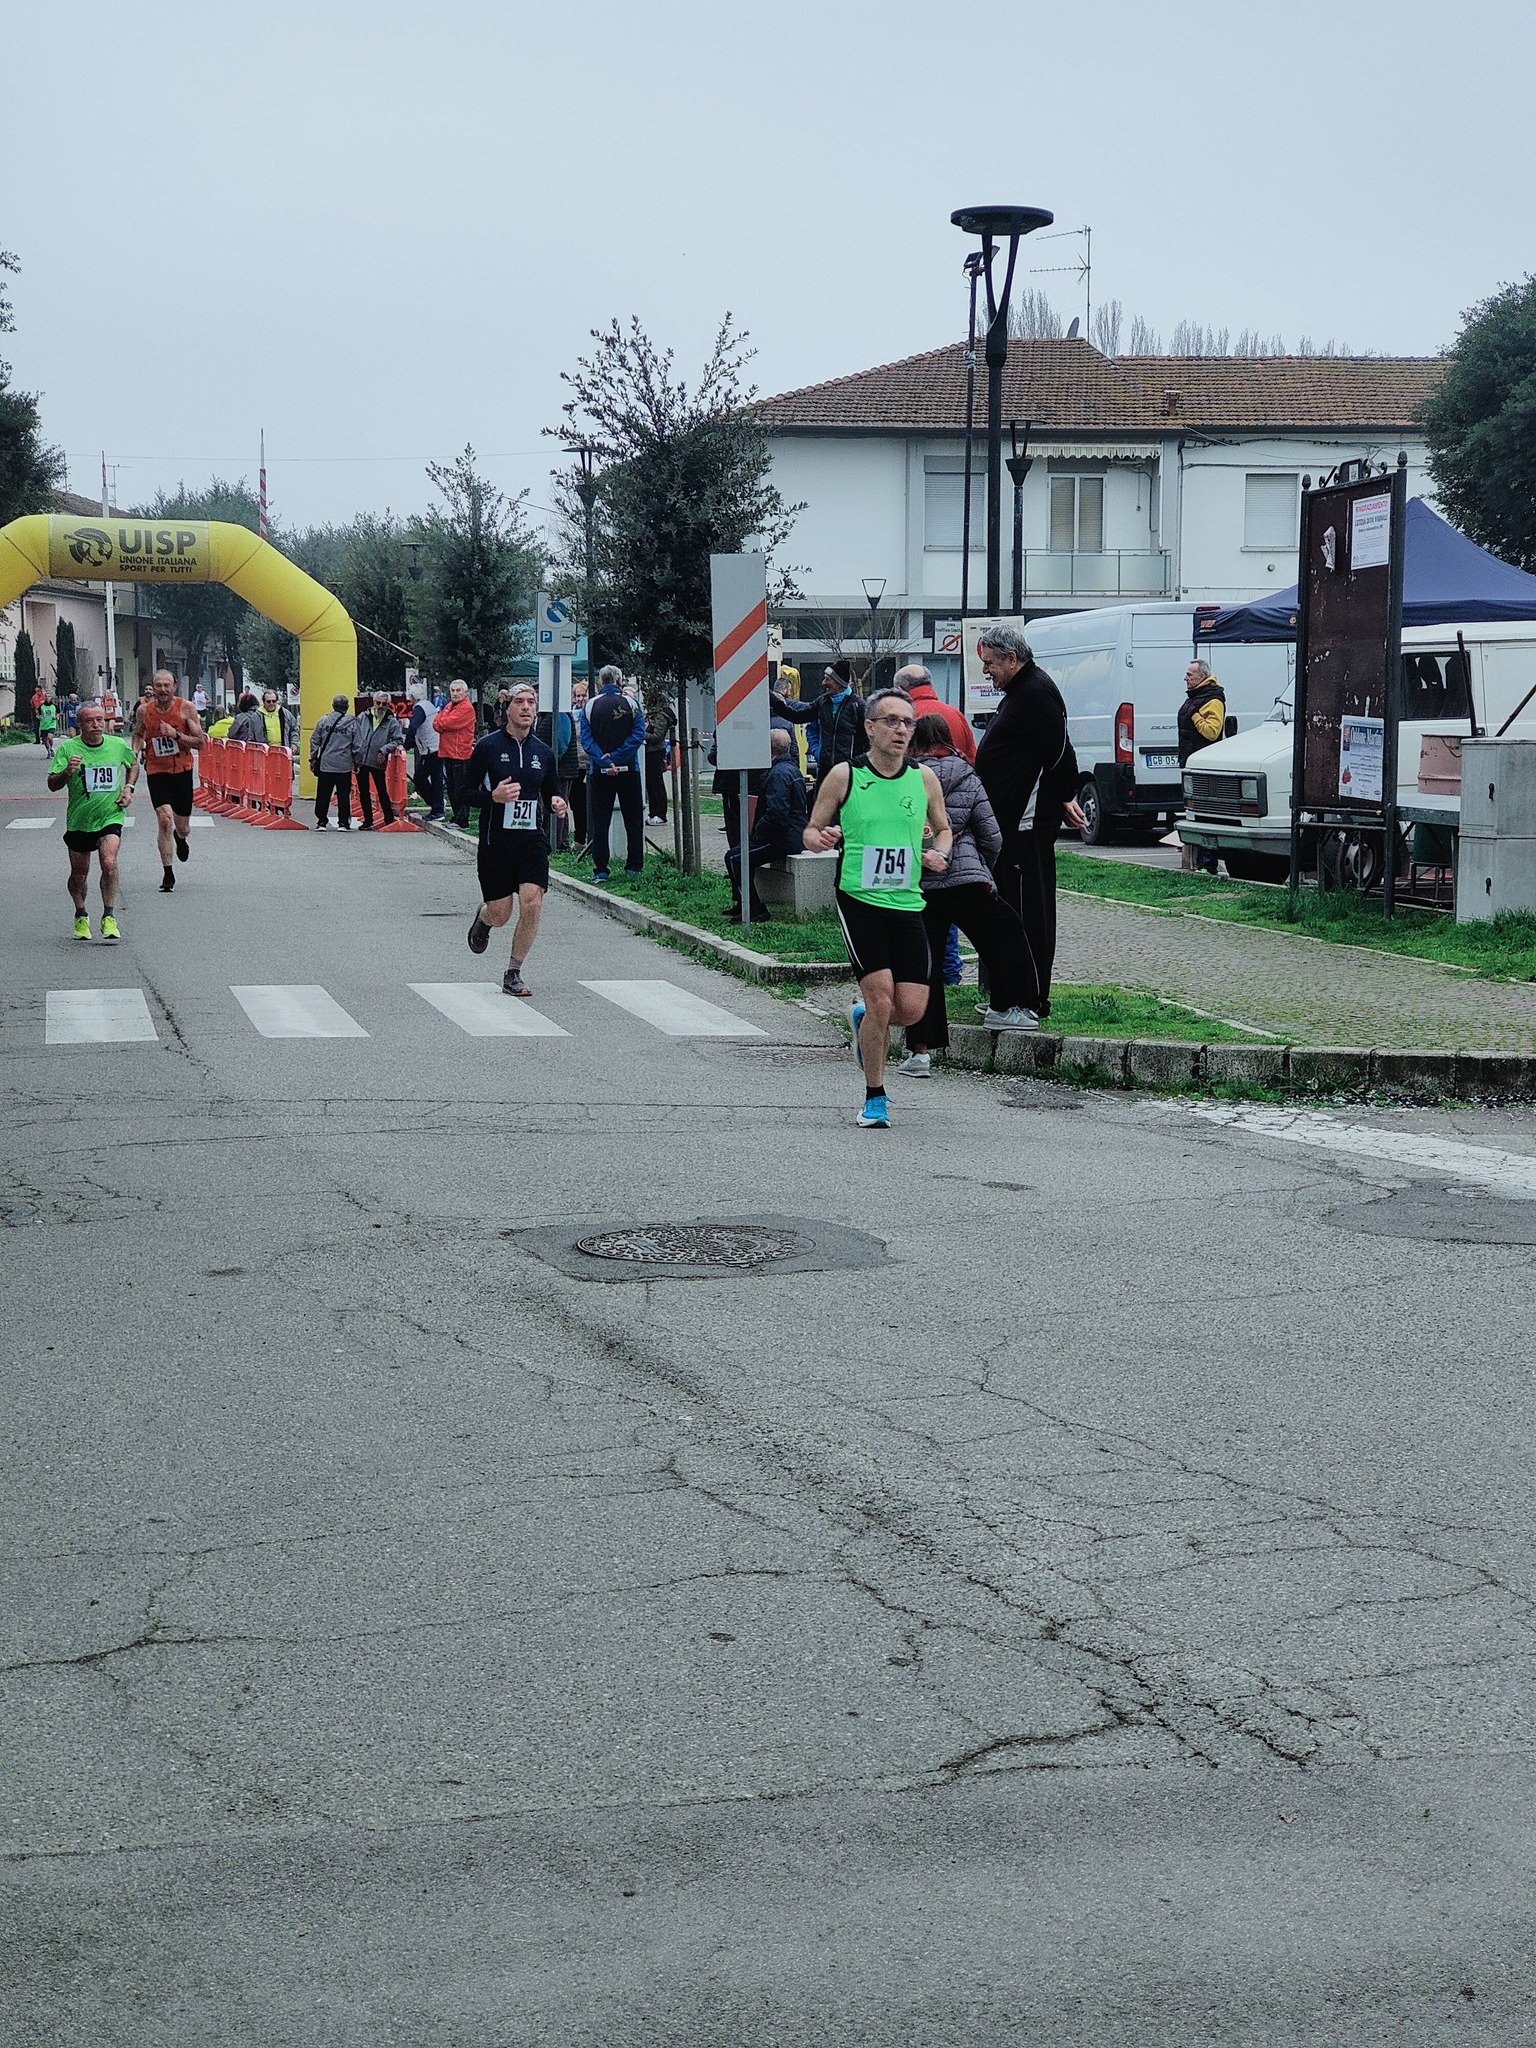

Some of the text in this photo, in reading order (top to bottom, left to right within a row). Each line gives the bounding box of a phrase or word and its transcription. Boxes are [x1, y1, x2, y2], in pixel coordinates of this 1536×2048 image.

[118, 529, 196, 555] UISP
[119, 556, 197, 566] UNIONE ITALIANA
[119, 565, 147, 573] SPORT
[170, 566, 193, 574] TUTTI
[542, 632, 550, 642] P
[92, 767, 113, 783] 739
[513, 801, 532, 820] 521
[874, 848, 906, 875] 754
